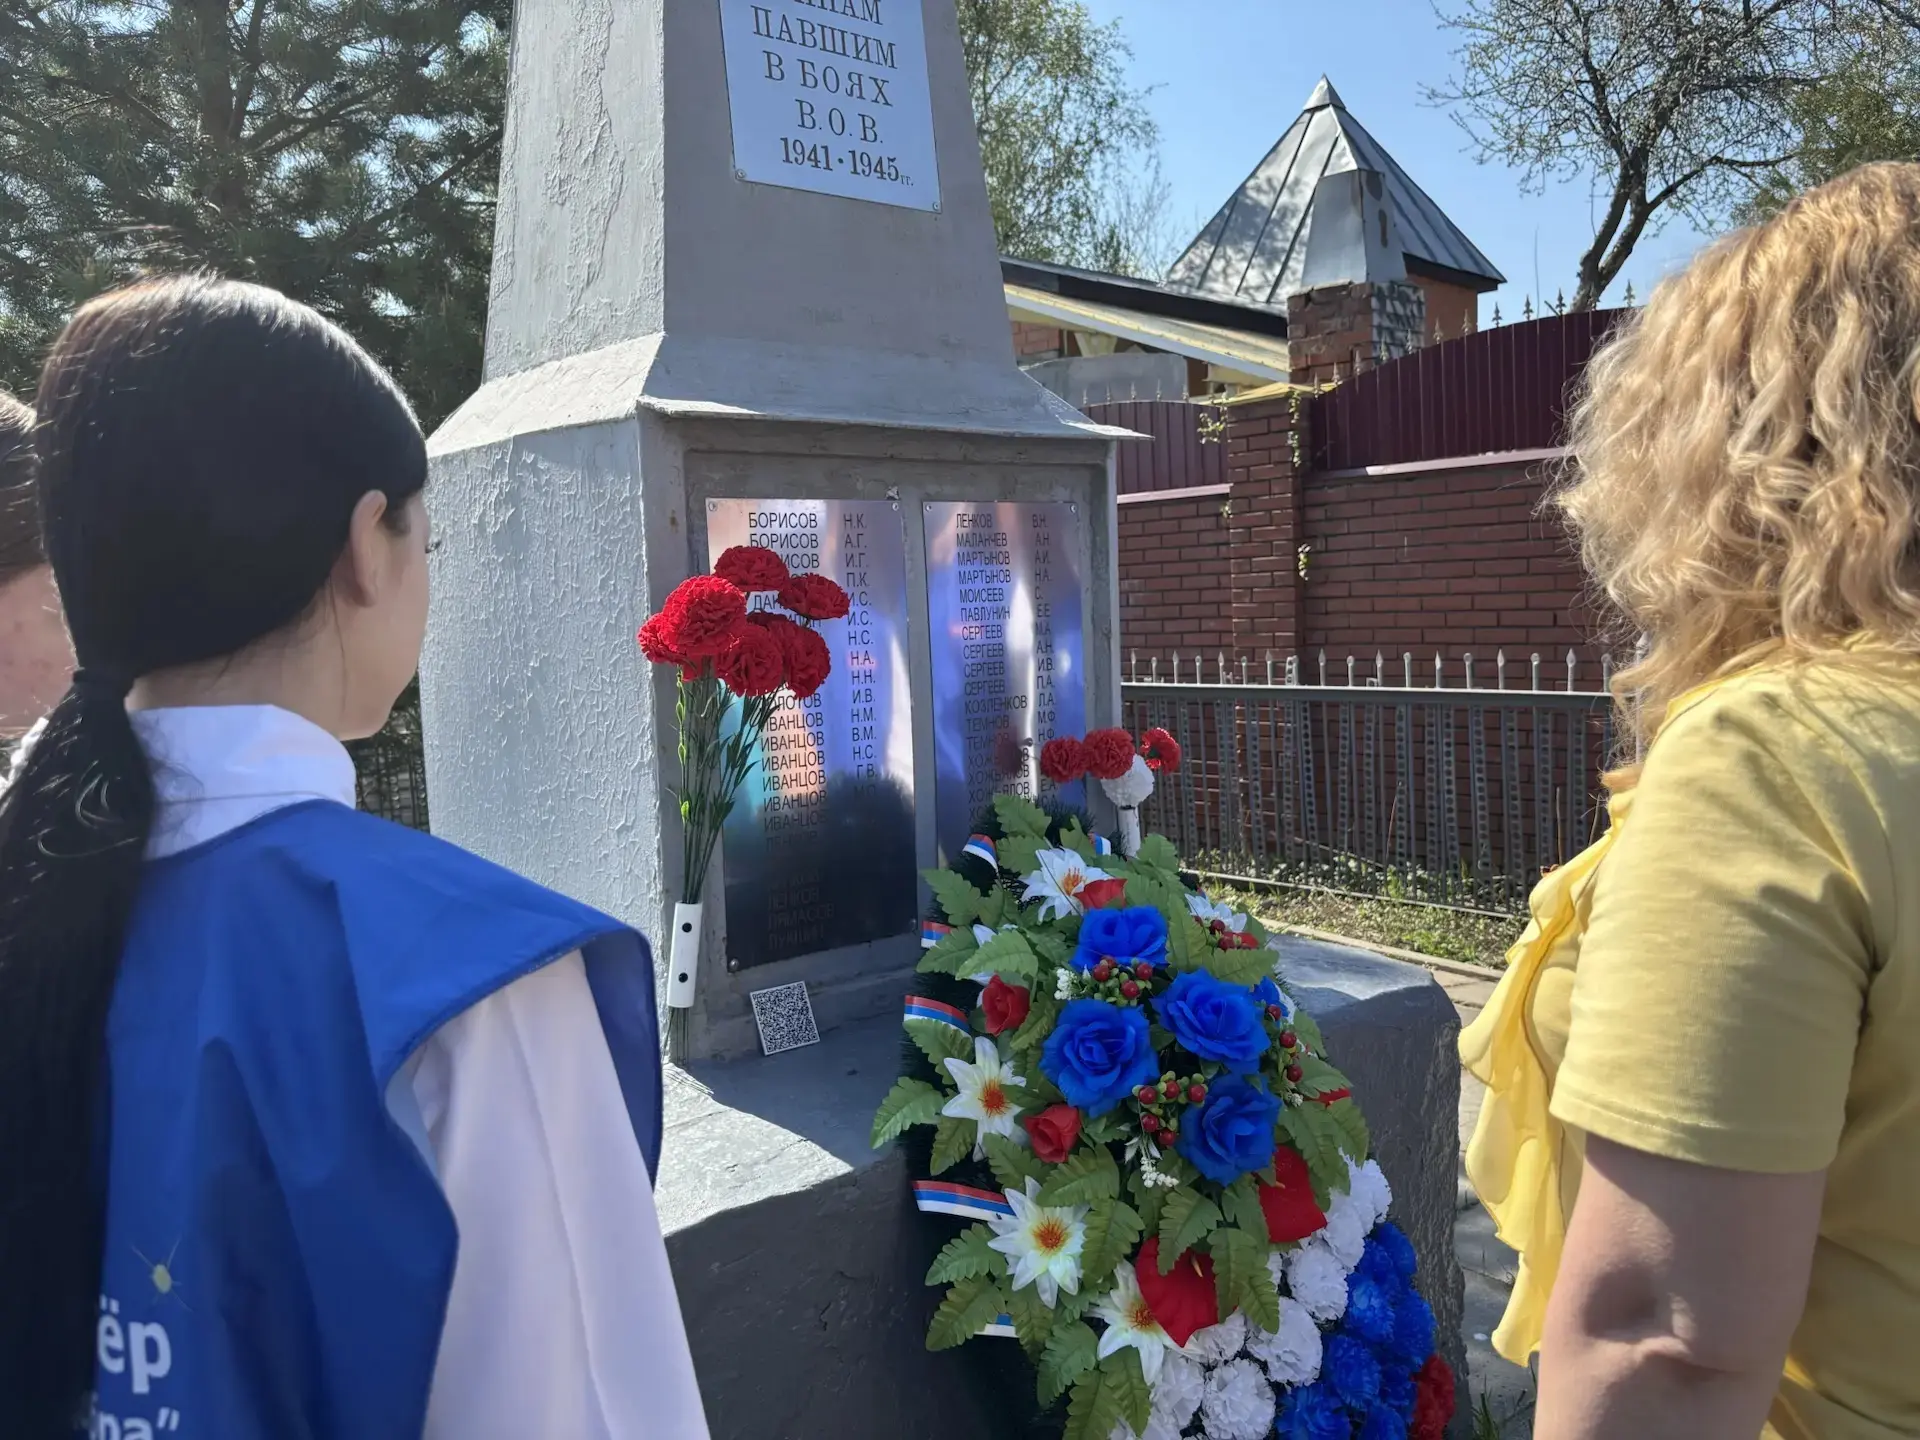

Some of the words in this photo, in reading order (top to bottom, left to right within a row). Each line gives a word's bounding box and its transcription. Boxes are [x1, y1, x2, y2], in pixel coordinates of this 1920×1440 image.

[750, 5, 898, 69] ПАВШИМ
[762, 50, 785, 81] В
[797, 58, 893, 107] БОЯХ
[749, 512, 818, 529] БОРИСОВ
[843, 512, 868, 529] Н.К.
[956, 513, 993, 529] ЛЕНКОВ
[750, 533, 819, 549] БОРИСОВ
[845, 533, 867, 548] А.Г.
[846, 553, 869, 568] И.Г.
[958, 551, 1011, 566] МАРТЫНОВ
[959, 569, 1011, 585] МАРТЫНОВ
[960, 588, 1005, 603] МОИСЕЕВ
[848, 610, 873, 626] И.С.
[961, 606, 1011, 622] ПАВЛУНИН
[848, 629, 873, 646] Н.С.
[962, 624, 1003, 640] СЕРГЕЕВ
[851, 650, 874, 666] Н.А.
[963, 643, 1004, 659] СЕРГЕЕВ
[852, 669, 875, 685] Н.Н.
[964, 661, 1005, 678] СЕРГЕЕВ
[852, 688, 876, 704] И.В.
[965, 680, 1005, 696] СЕРГЕЕВ
[851, 707, 876, 723] Н.М.
[966, 714, 1010, 732] ТЕМНОВ
[761, 731, 825, 752] ИВАНЦОВ
[852, 726, 877, 741] В.М.
[762, 751, 825, 772] ИВАНЦОВ
[853, 744, 877, 760] Н.С.
[763, 770, 826, 792] ИВАНЦОВ
[763, 790, 827, 812] ИВАНЦОВ
